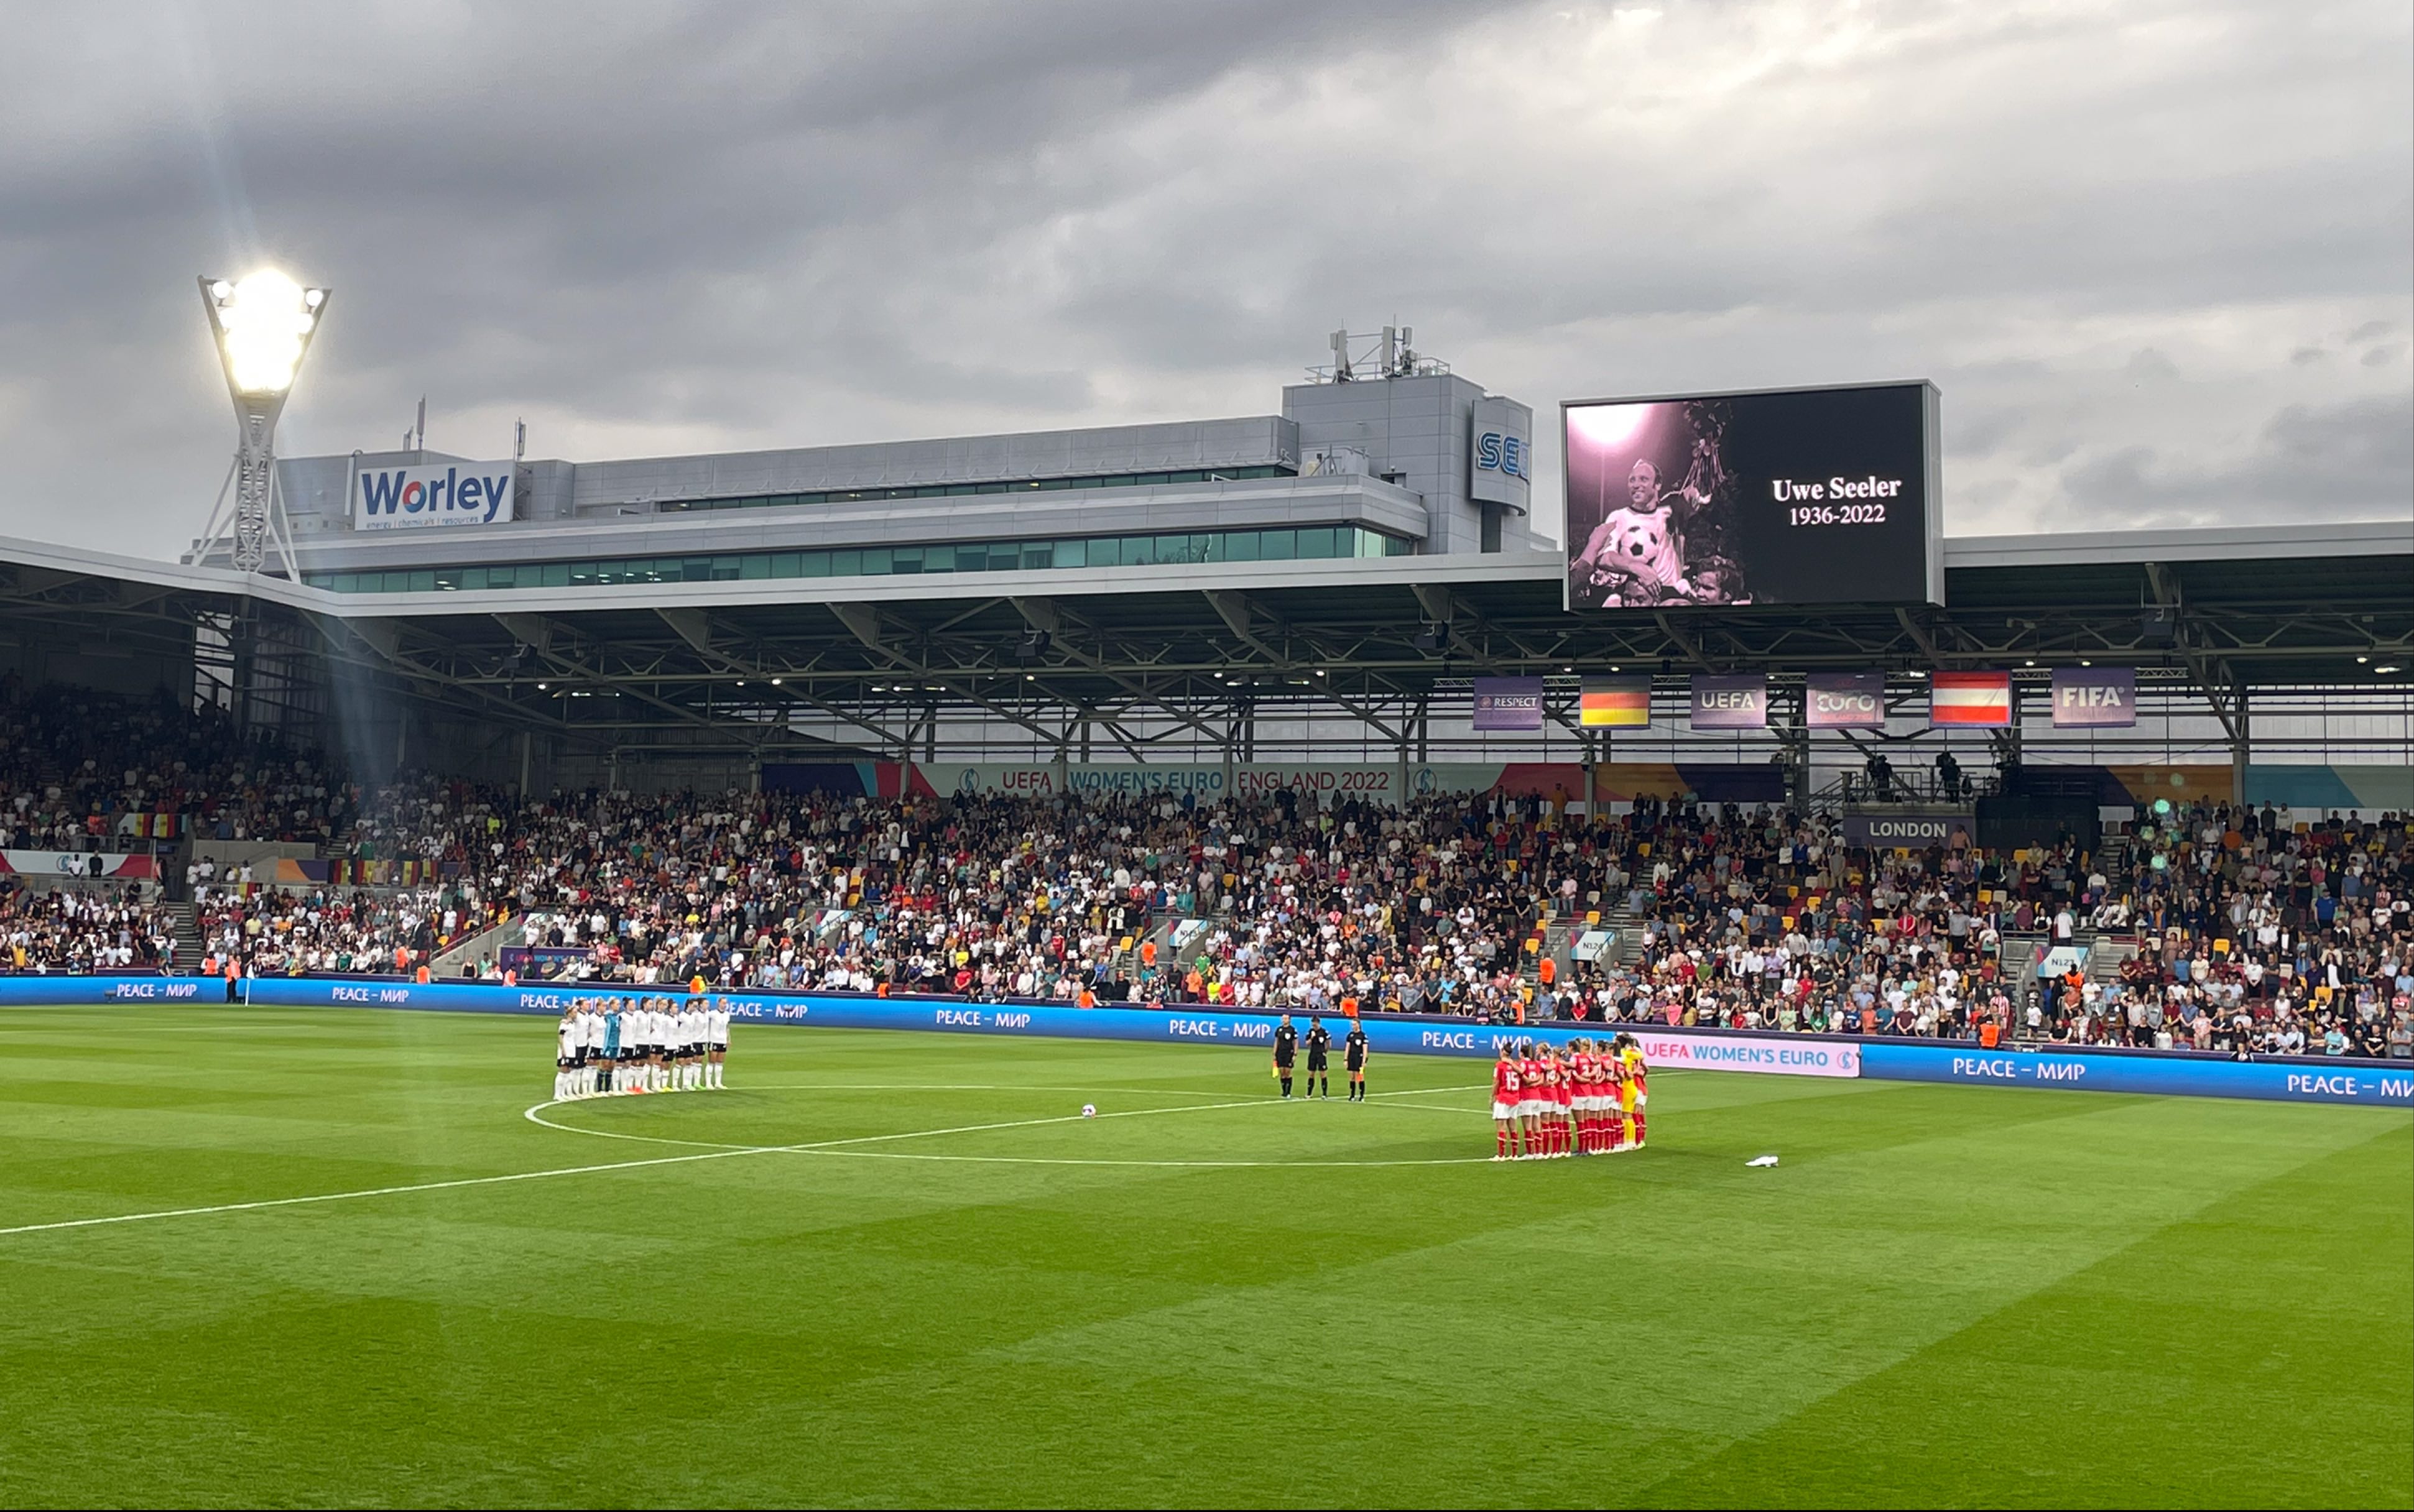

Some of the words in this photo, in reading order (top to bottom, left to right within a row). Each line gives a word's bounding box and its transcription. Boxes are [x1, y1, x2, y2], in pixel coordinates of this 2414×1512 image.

[1478, 431, 1530, 478] SE
[361, 468, 509, 523] Worley
[1772, 479, 1823, 502] Uwe
[1829, 476, 1902, 499] Seeler
[1790, 504, 1885, 526] 1936-2022
[1494, 697, 1537, 707] RESPECT
[1701, 692, 1755, 708] UEFA
[2062, 687, 2121, 707] FIFA
[1002, 772, 1052, 790] UEFA
[1070, 772, 1162, 790] WOMEN'S
[1168, 772, 1223, 790] EURO
[1238, 772, 1336, 790] ENGLAND
[1341, 772, 1389, 790] 2022
[1869, 822, 1946, 837] LONDON
[117, 984, 155, 997] PEACE
[165, 984, 197, 997] МИР
[332, 987, 369, 1002] PEACE
[380, 990, 409, 1003] МИР
[520, 994, 559, 1008] PEACE
[936, 1010, 981, 1025] PEACE
[995, 1013, 1030, 1028] МИР
[1170, 1020, 1217, 1036] PEACE
[1233, 1023, 1270, 1039] МИР
[1422, 1031, 1474, 1049] PEACE
[1645, 1043, 1689, 1058] UEFA
[1693, 1045, 1775, 1064] WOMEN'S
[1780, 1050, 1829, 1066] EURO
[1953, 1058, 2016, 1077] PEACE
[2037, 1063, 2085, 1080] МИР
[1506, 1072, 1519, 1091] 15
[2288, 1074, 2357, 1095] PEACE
[2381, 1079, 2413, 1097] МИ
